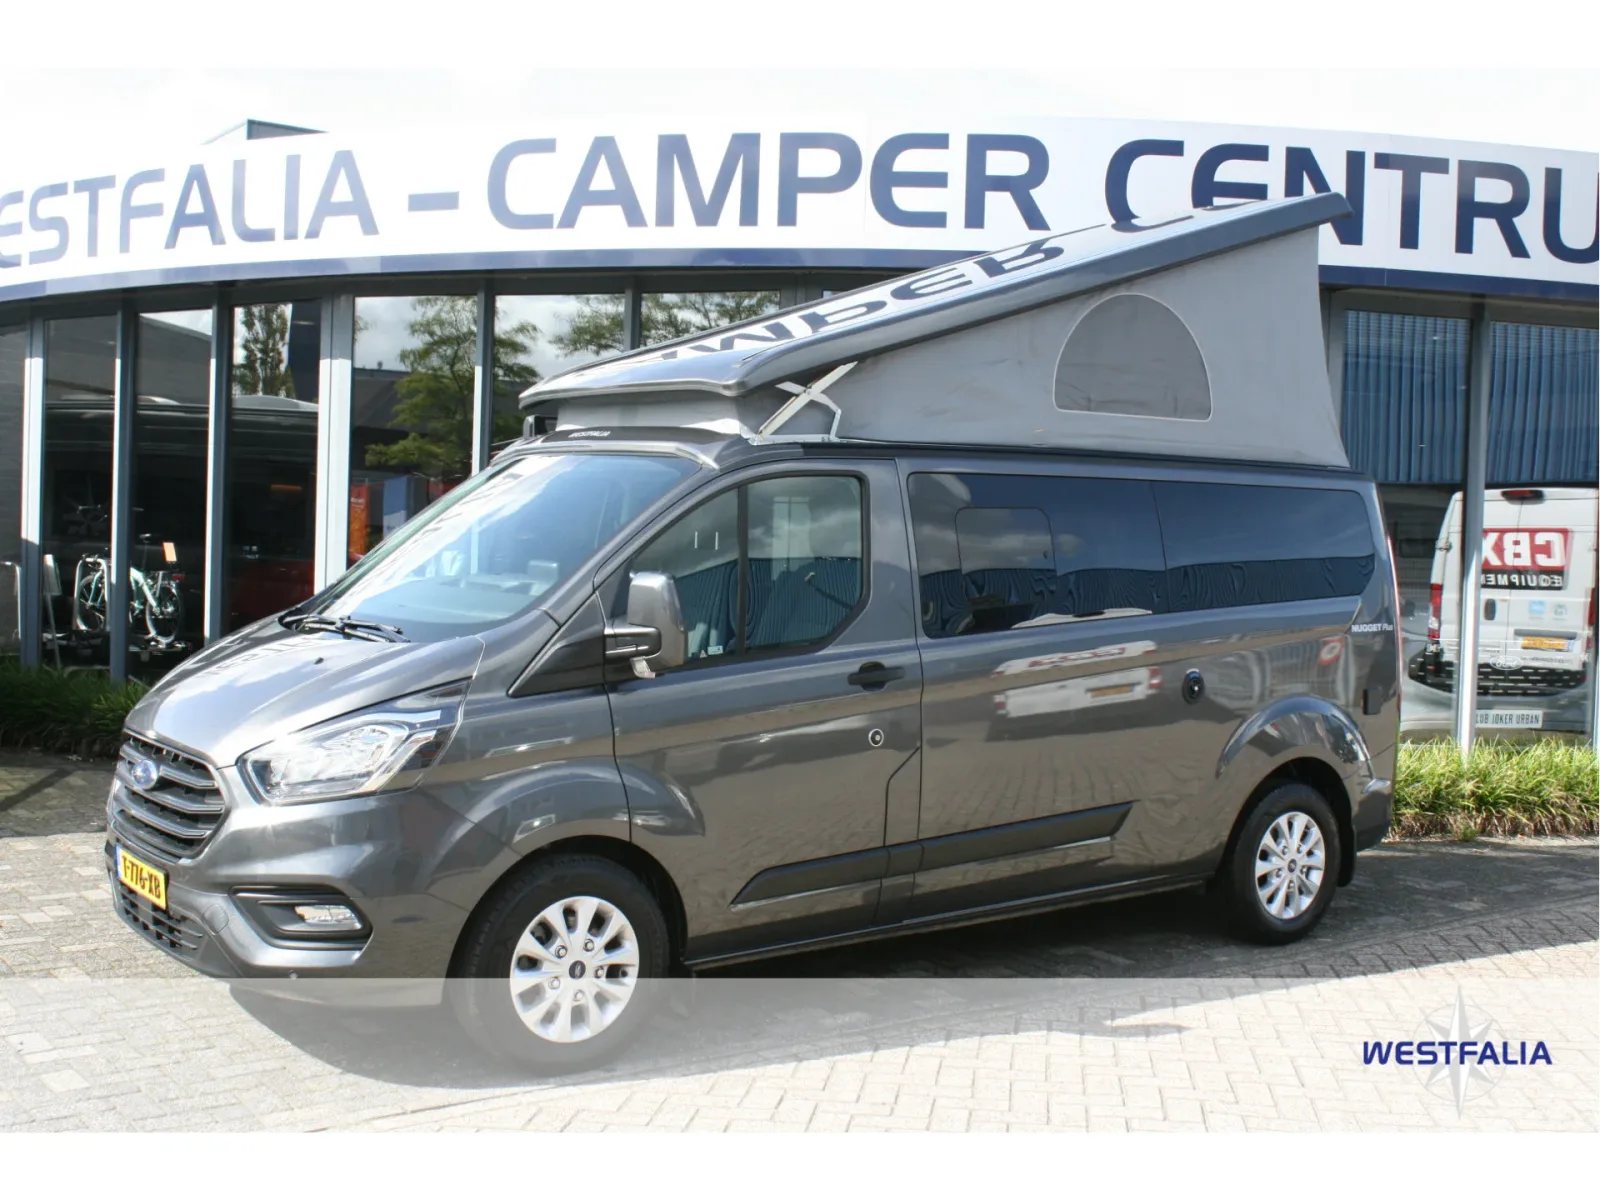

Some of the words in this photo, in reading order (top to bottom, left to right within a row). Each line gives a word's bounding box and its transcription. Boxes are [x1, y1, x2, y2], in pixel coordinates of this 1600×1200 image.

[488, 132, 1051, 231] CAMPER
[1105, 139, 1599, 263] CENTRU
[1351, 624, 1382, 632] NUGGET
[1492, 713, 1513, 724] JOKER
[1516, 713, 1539, 724] URBAN
